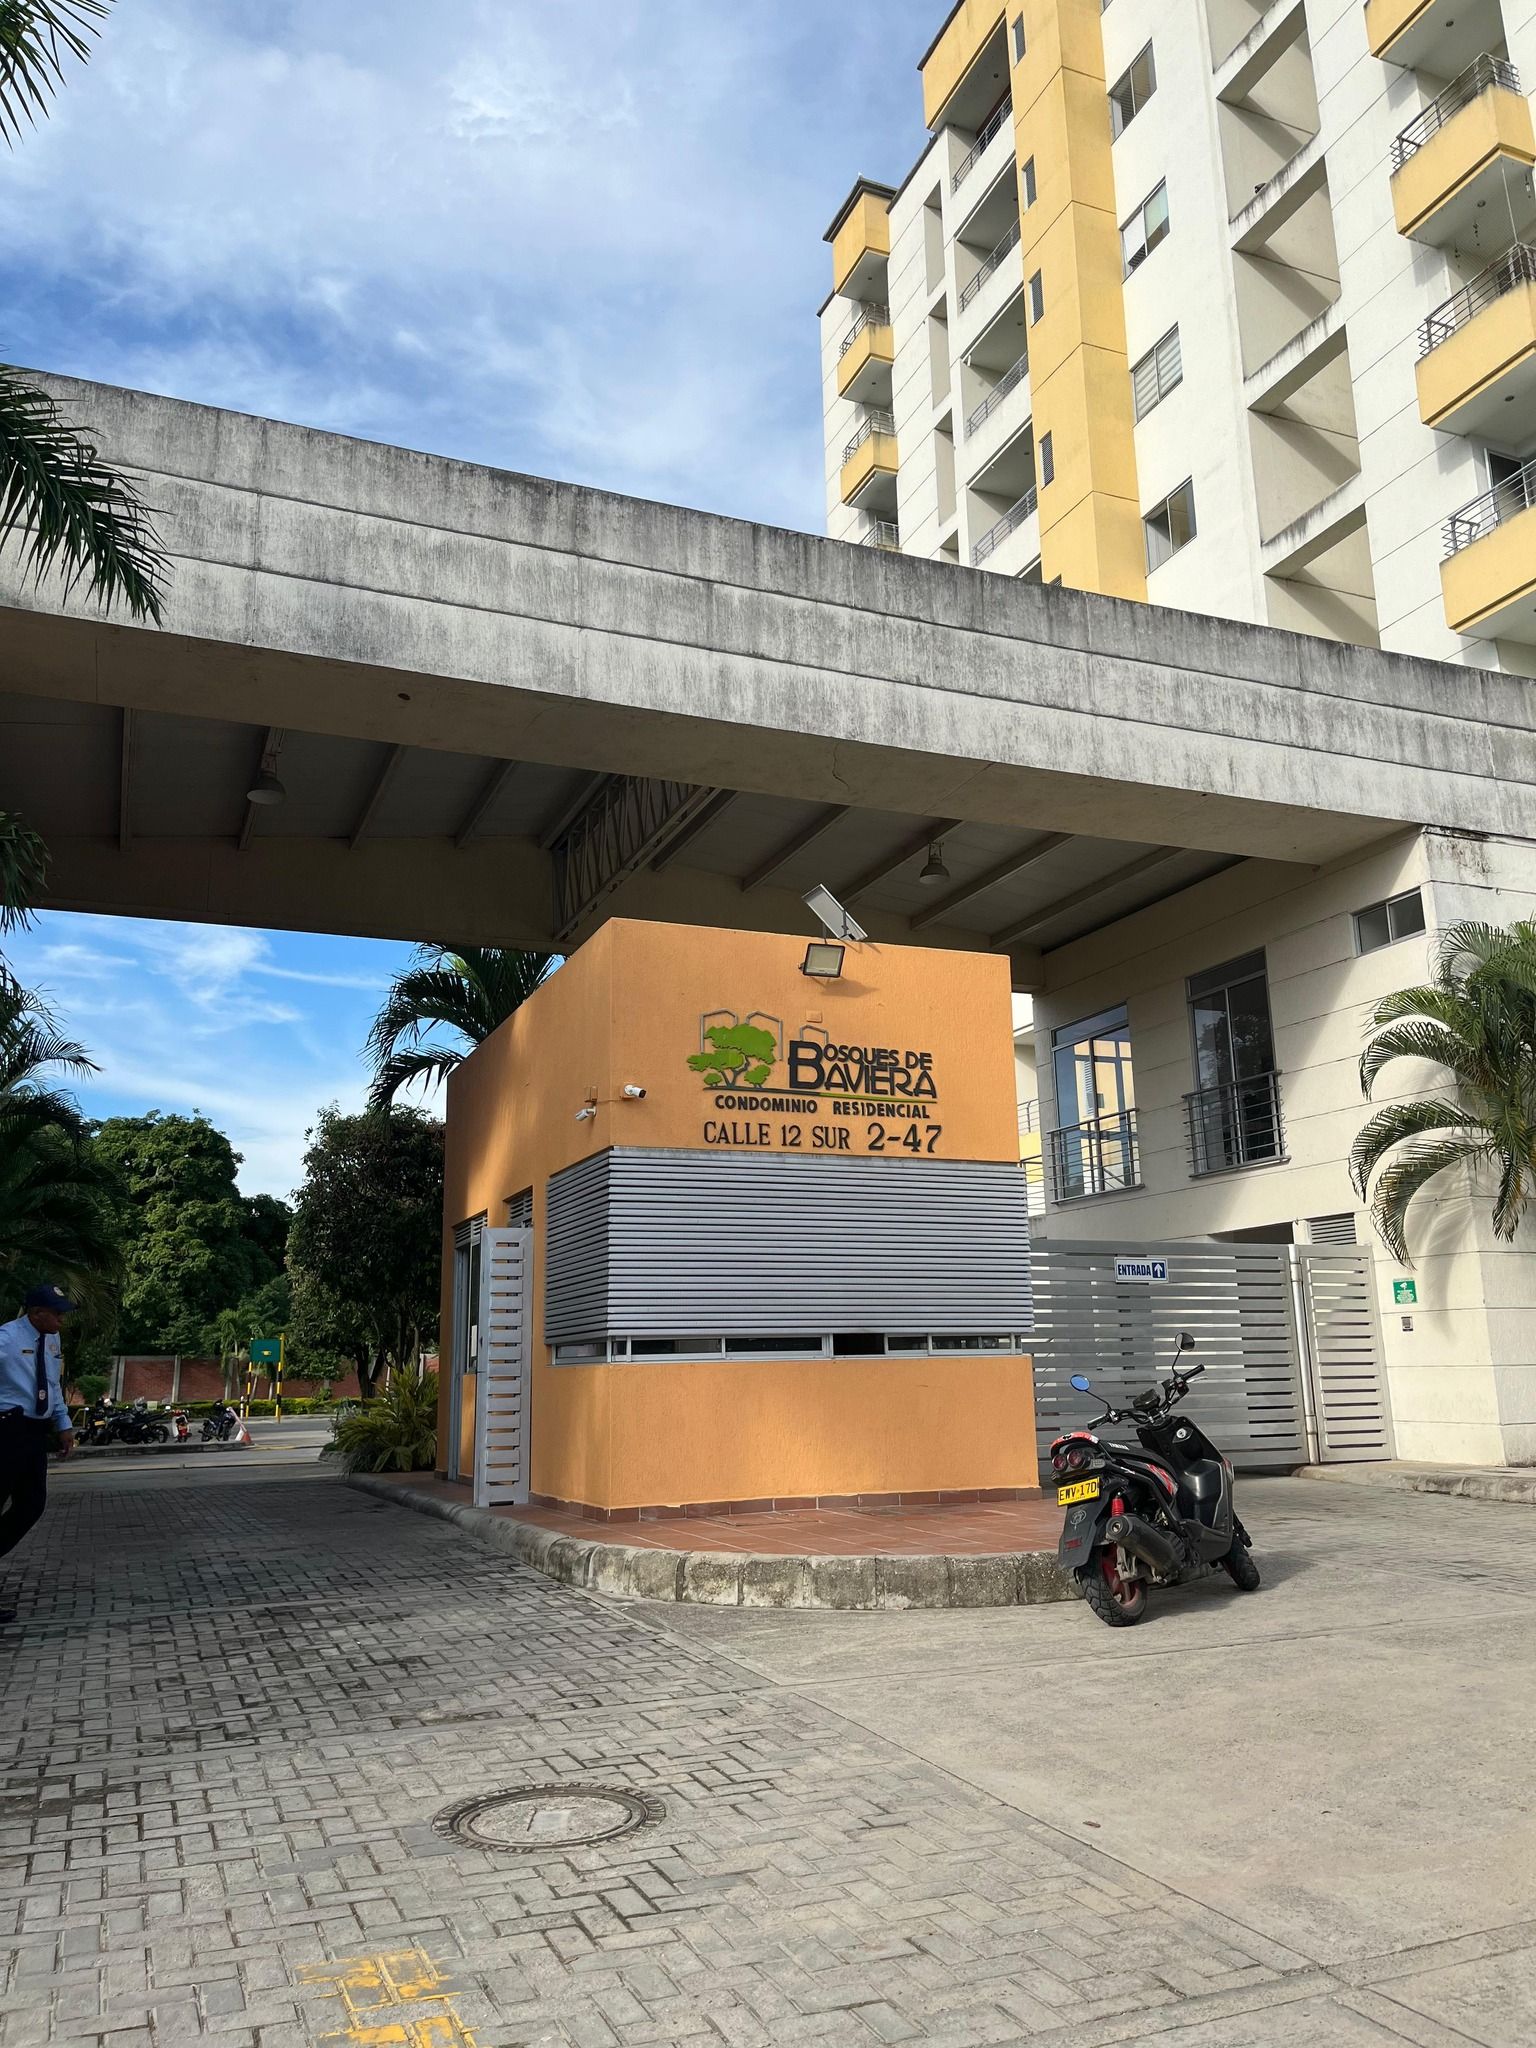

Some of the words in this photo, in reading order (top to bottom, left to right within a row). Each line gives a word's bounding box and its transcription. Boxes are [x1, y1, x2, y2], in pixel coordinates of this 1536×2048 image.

[905, 1051, 933, 1070] DE
[715, 1094, 818, 1113] CONDOMINIO
[833, 1100, 930, 1118] RESIDENCIAL
[703, 1121, 771, 1146] CALLE
[781, 1124, 801, 1147] 12
[812, 1126, 850, 1150] SUR
[867, 1122, 942, 1153] 2-47
[1117, 1264, 1151, 1276] ENTRADA
